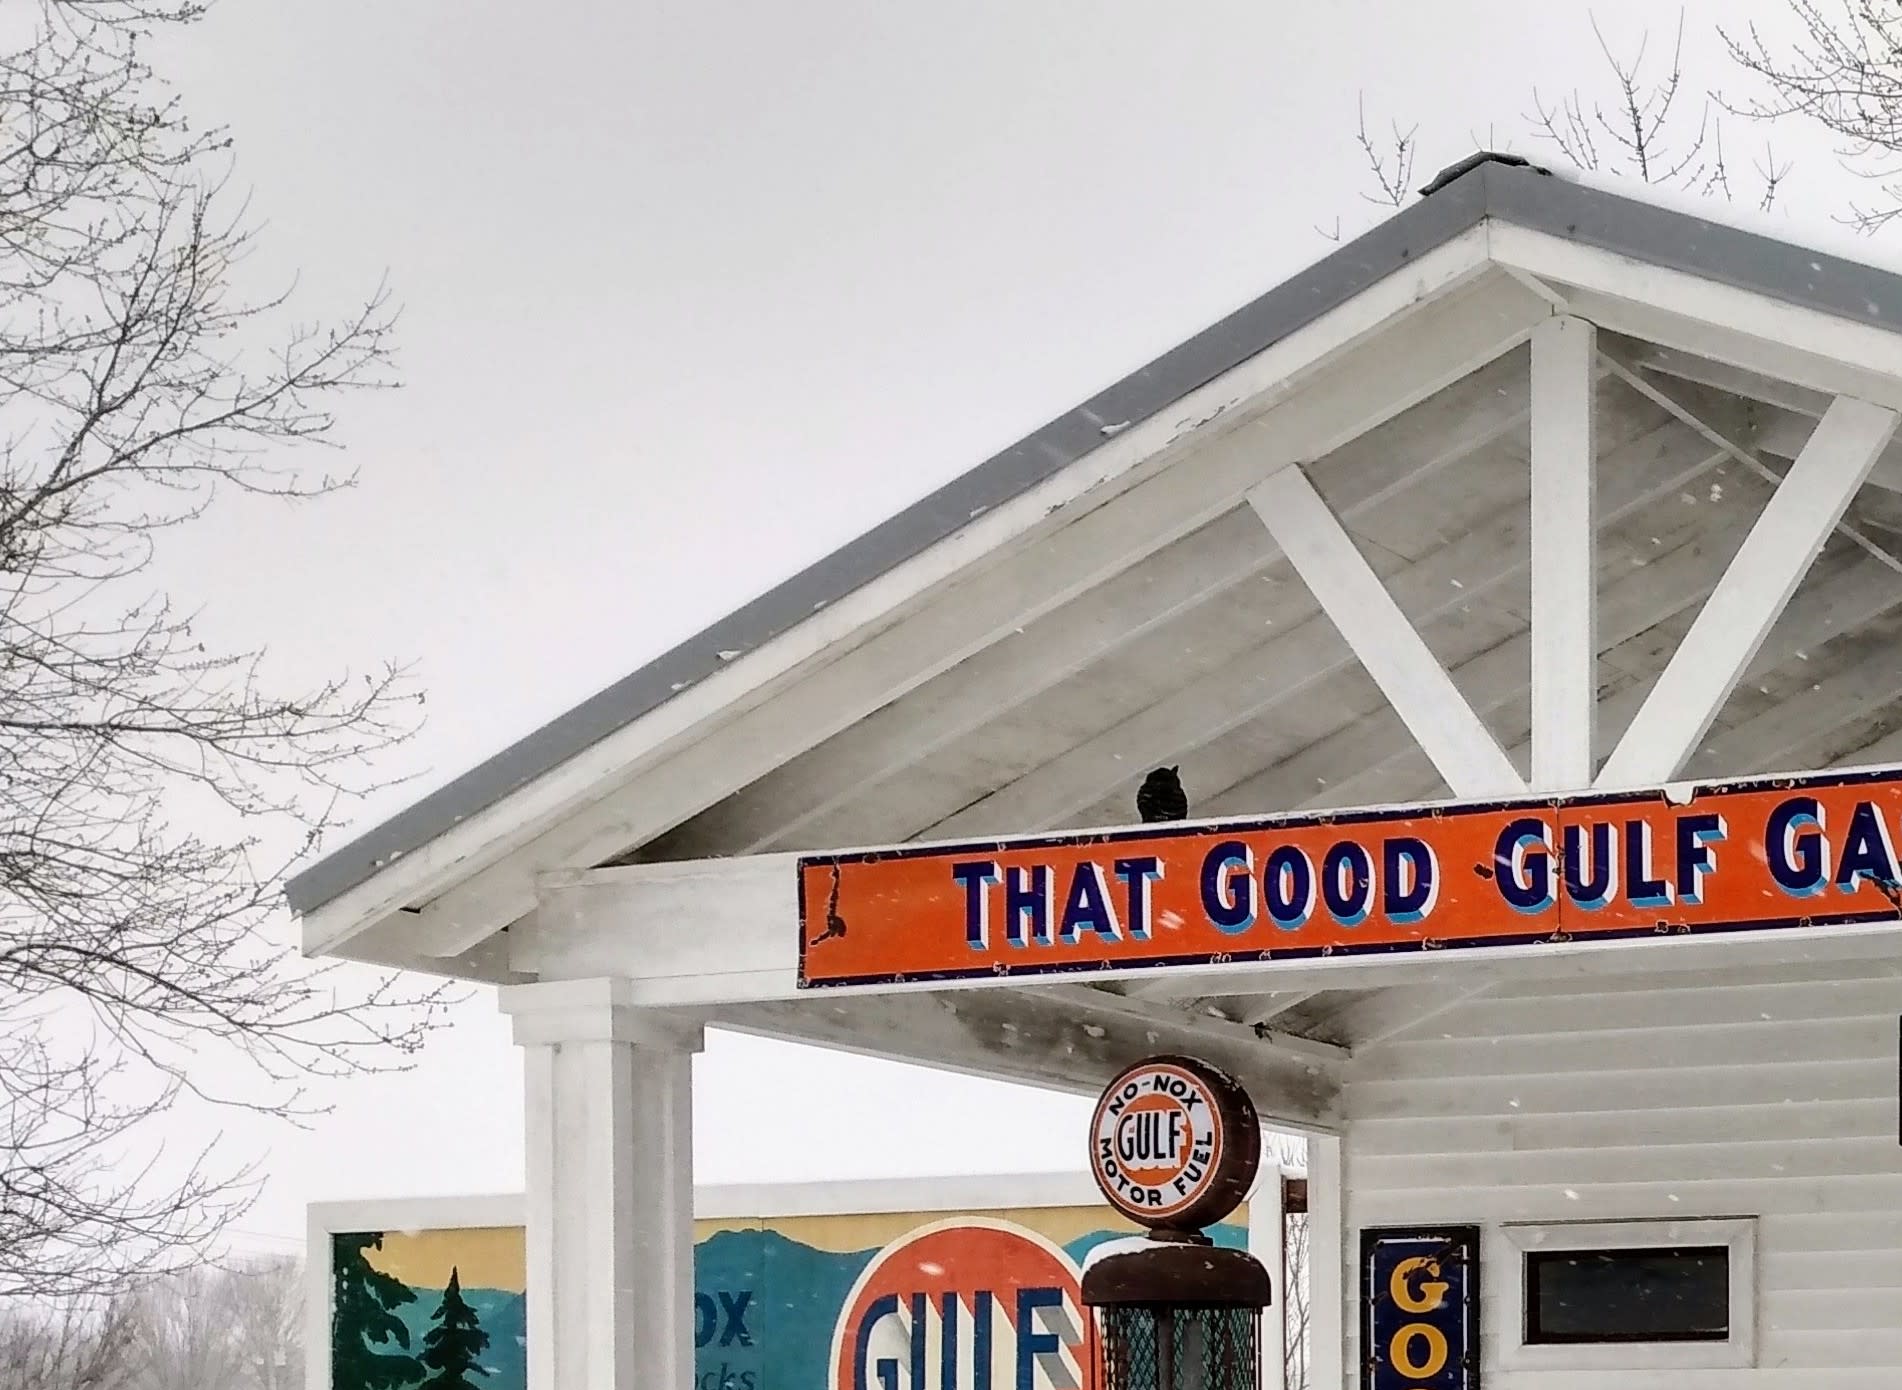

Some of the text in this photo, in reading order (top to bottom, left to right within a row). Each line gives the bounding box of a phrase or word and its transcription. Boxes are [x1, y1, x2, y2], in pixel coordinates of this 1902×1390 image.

[953, 856, 1166, 951] THAT
[1200, 837, 1440, 934] GOOD
[1494, 811, 1729, 915] GULF
[1109, 1074, 1204, 1116] NO-NOX
[1117, 1111, 1182, 1162] GULF
[1100, 1131, 1213, 1206] MOTOR FUEL
